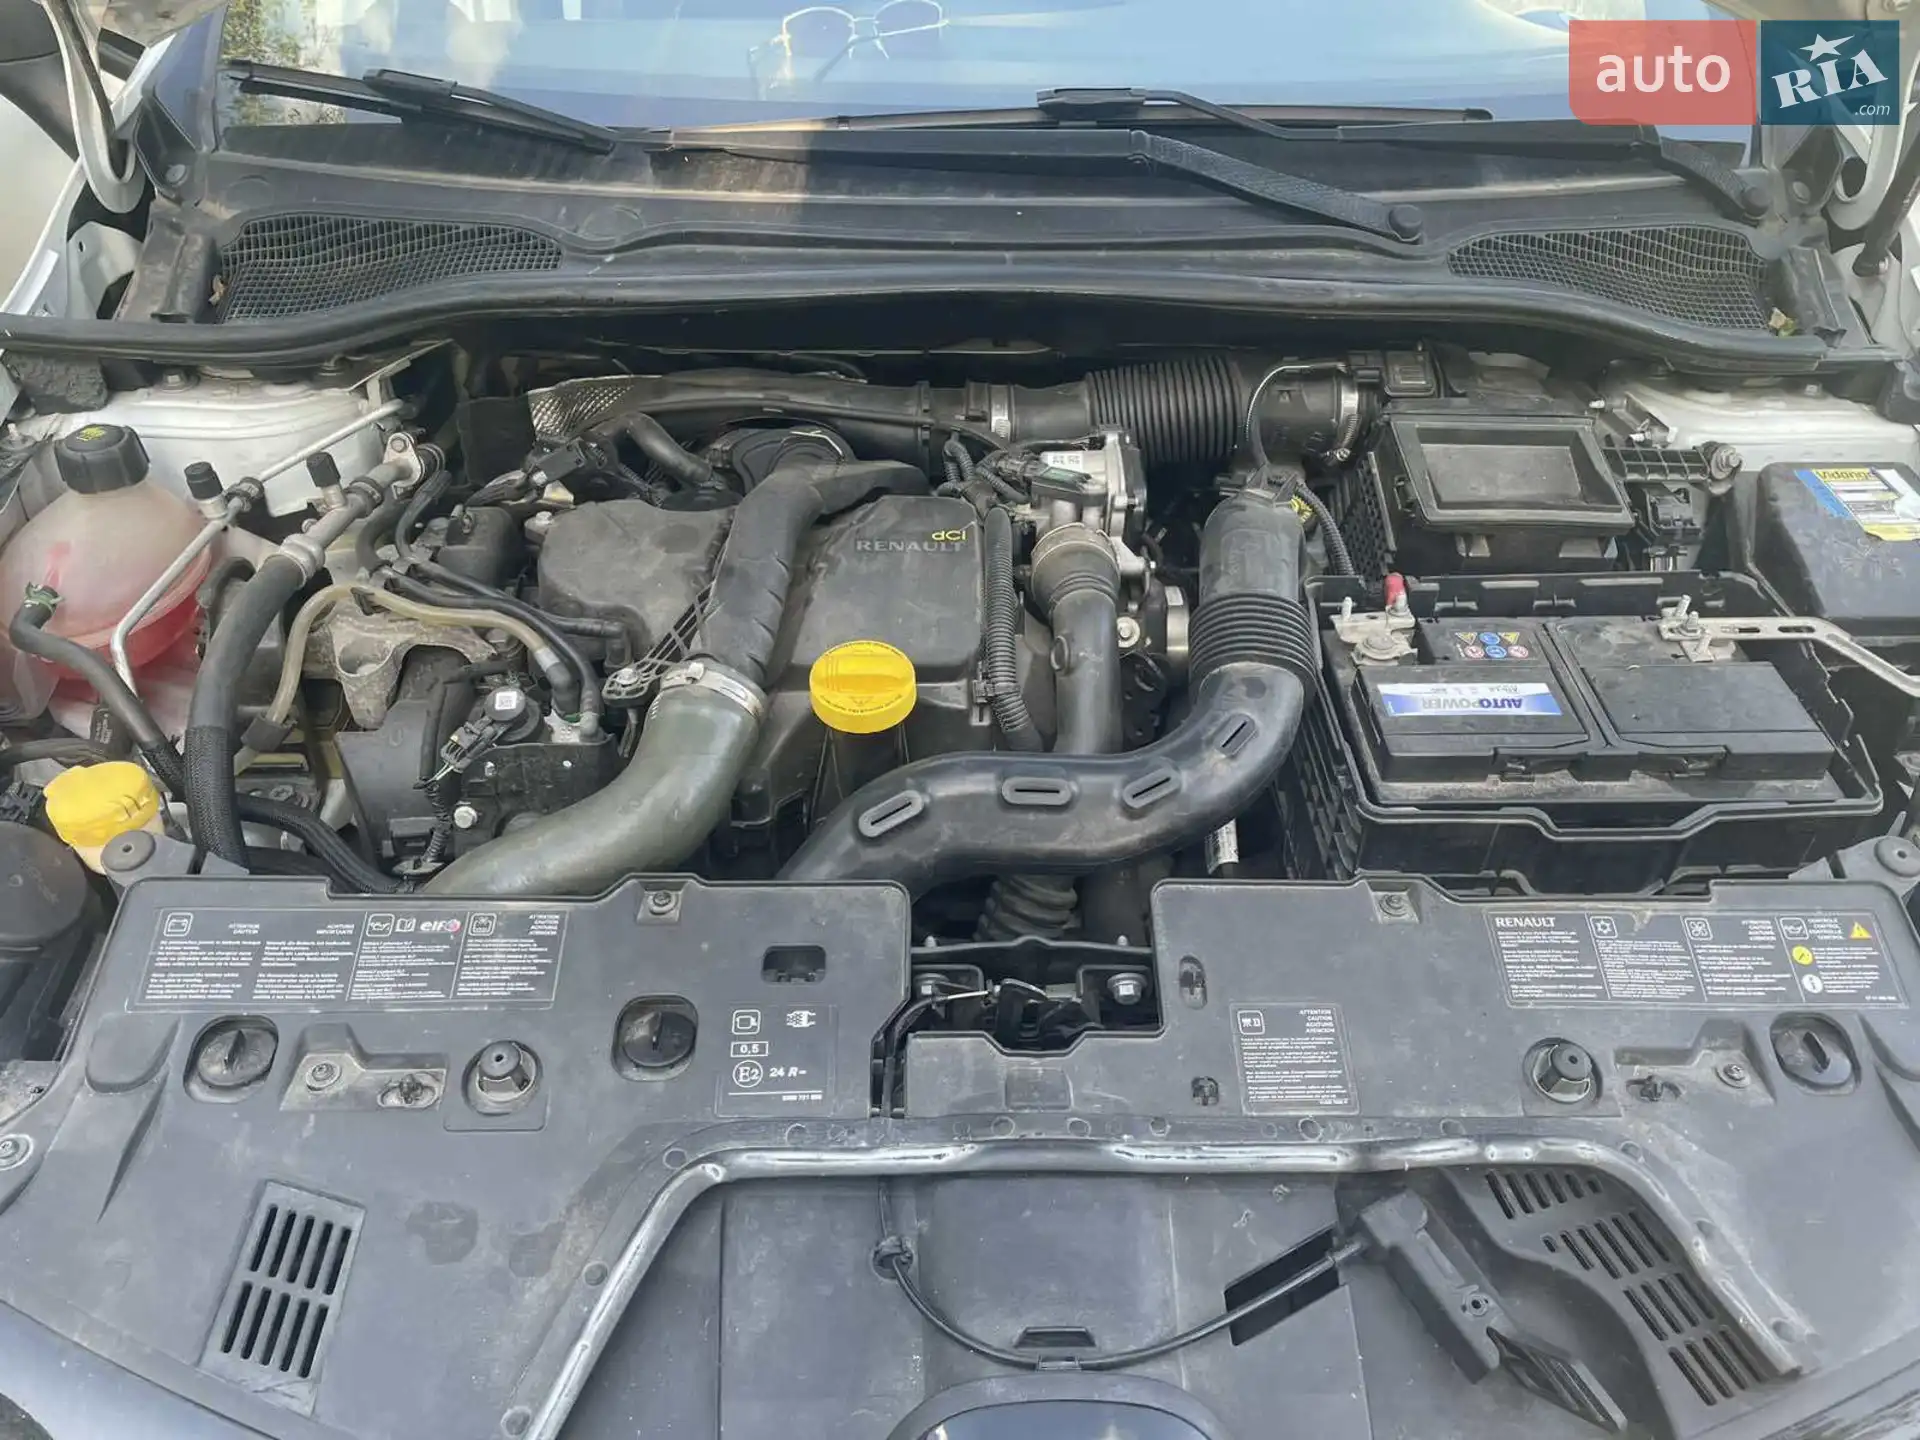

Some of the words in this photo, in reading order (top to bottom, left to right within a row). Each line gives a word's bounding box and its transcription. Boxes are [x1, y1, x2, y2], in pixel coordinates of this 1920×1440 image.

[856, 540, 965, 552] RENAULT
[1422, 698, 1523, 709] AUTOPOWER
[420, 920, 446, 931] elf
[1495, 917, 1556, 927] RENAULT
[769, 1067, 785, 1078] 24
